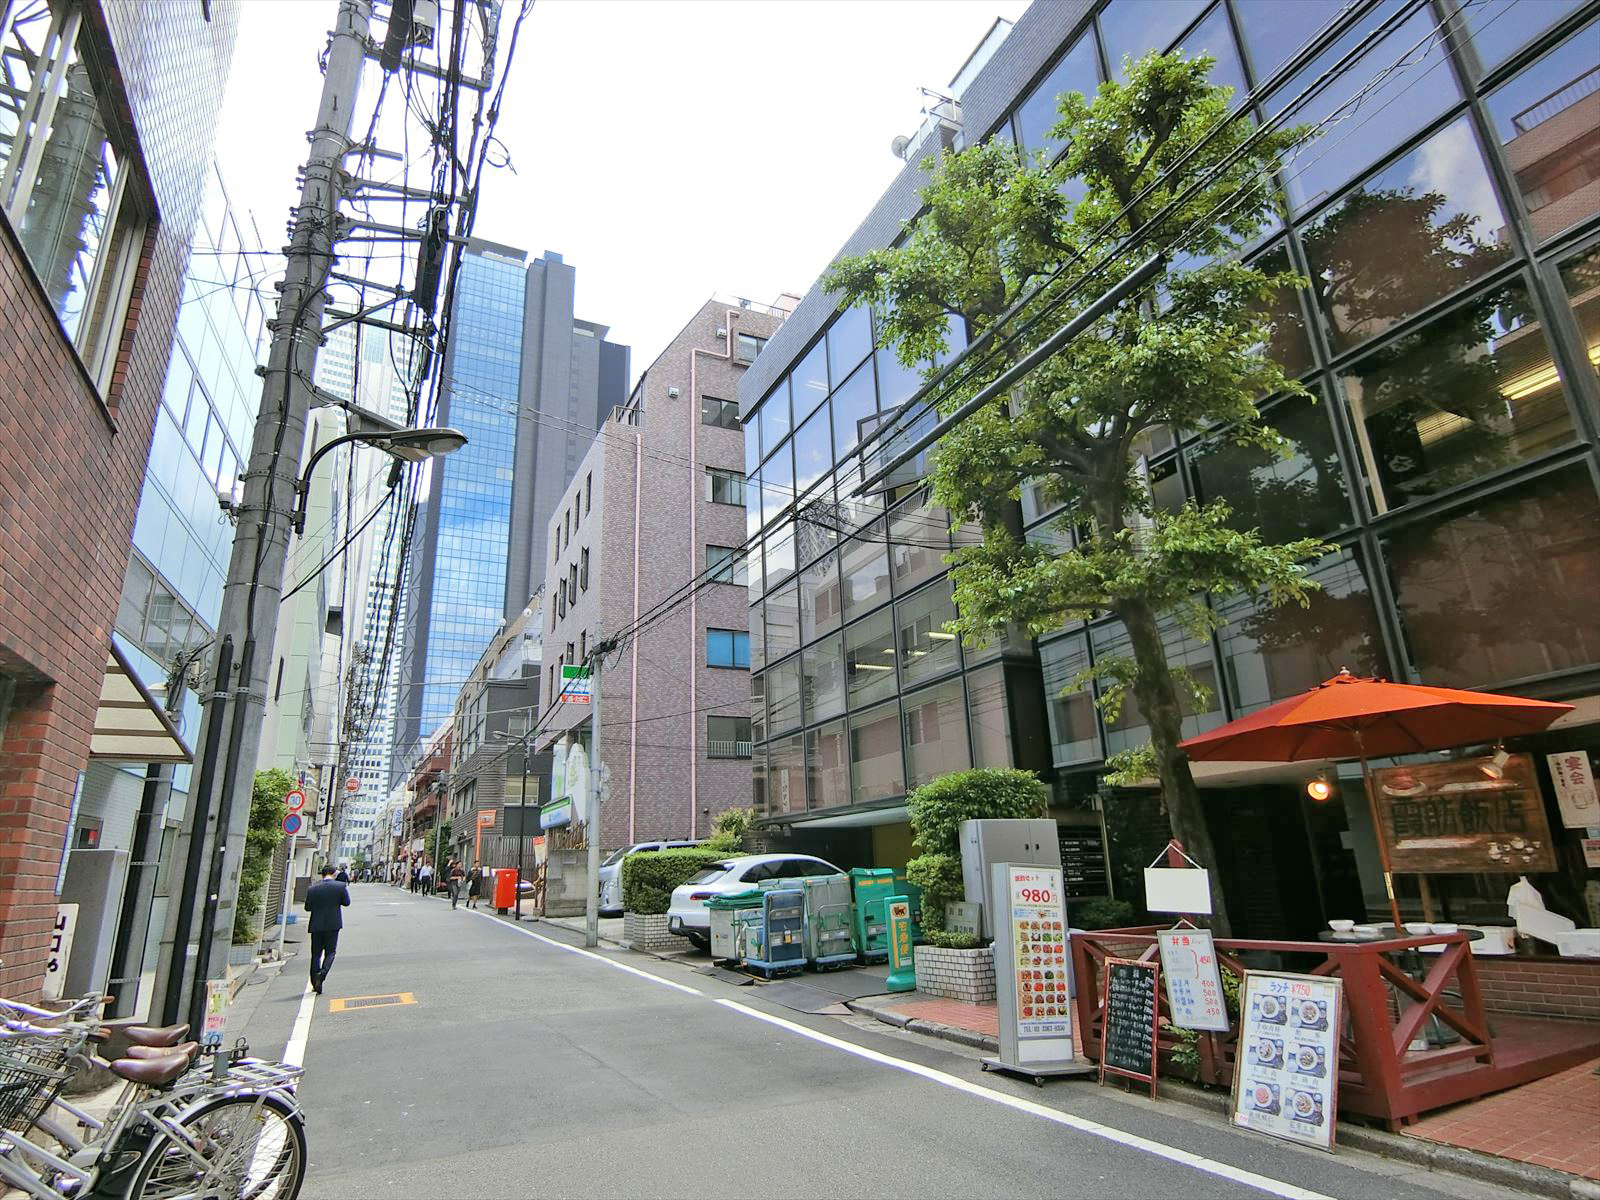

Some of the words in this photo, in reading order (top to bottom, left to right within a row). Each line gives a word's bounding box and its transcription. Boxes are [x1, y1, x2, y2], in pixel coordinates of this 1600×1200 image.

[290, 795, 301, 806] 30
[1270, 982, 1289, 992] ランチ
[1202, 989, 1217, 997] 500
[1205, 997, 1218, 1006] 500
[1206, 1007, 1220, 1016] 450
